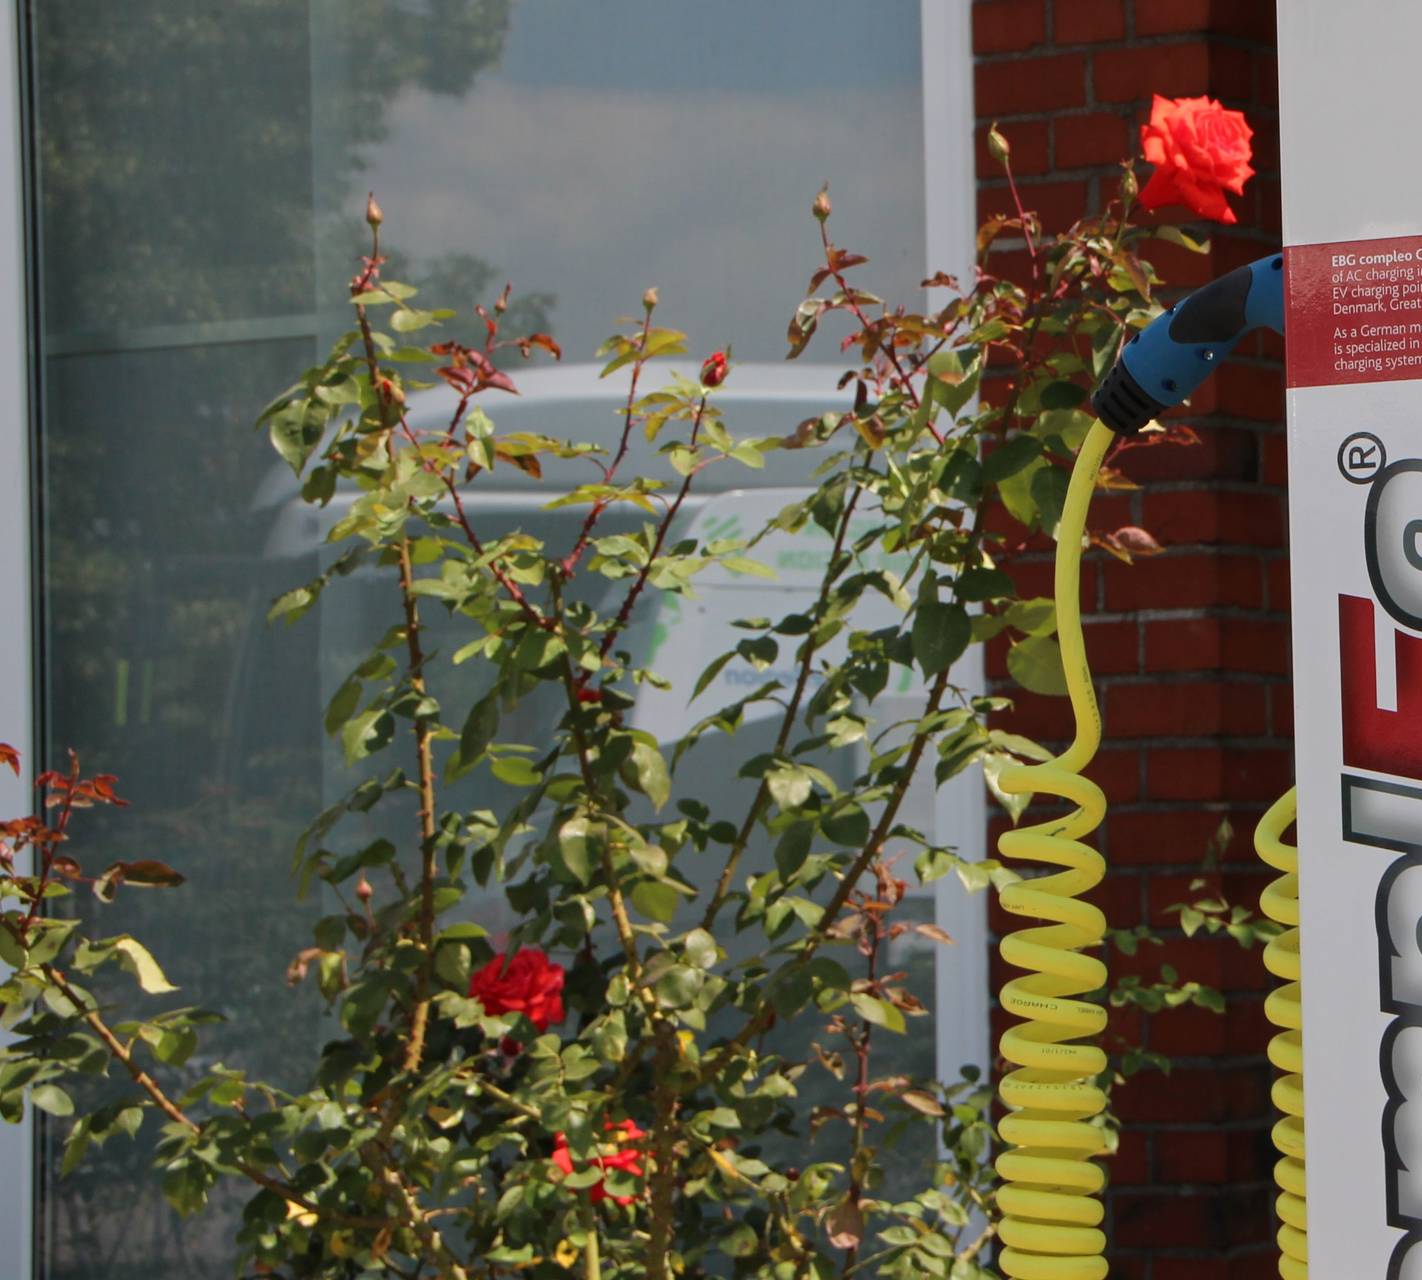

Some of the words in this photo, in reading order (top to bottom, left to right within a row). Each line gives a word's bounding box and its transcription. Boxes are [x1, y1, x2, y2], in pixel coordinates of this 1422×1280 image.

[1332, 254, 1356, 267] EBG
[1359, 251, 1412, 266] compleo
[1332, 271, 1344, 283] of
[1346, 269, 1362, 282] AC
[1365, 266, 1415, 282] charging
[1332, 287, 1347, 299] EV
[1351, 283, 1400, 299] charging
[1333, 301, 1387, 315] Denmark,
[1390, 298, 1421, 311] Great
[1334, 327, 1347, 339] As
[1350, 328, 1357, 337] a
[1361, 323, 1406, 337] German
[1334, 343, 1343, 355] is
[1346, 337, 1406, 356] specialized
[1410, 338, 1420, 349] in
[1334, 357, 1382, 372] charging
